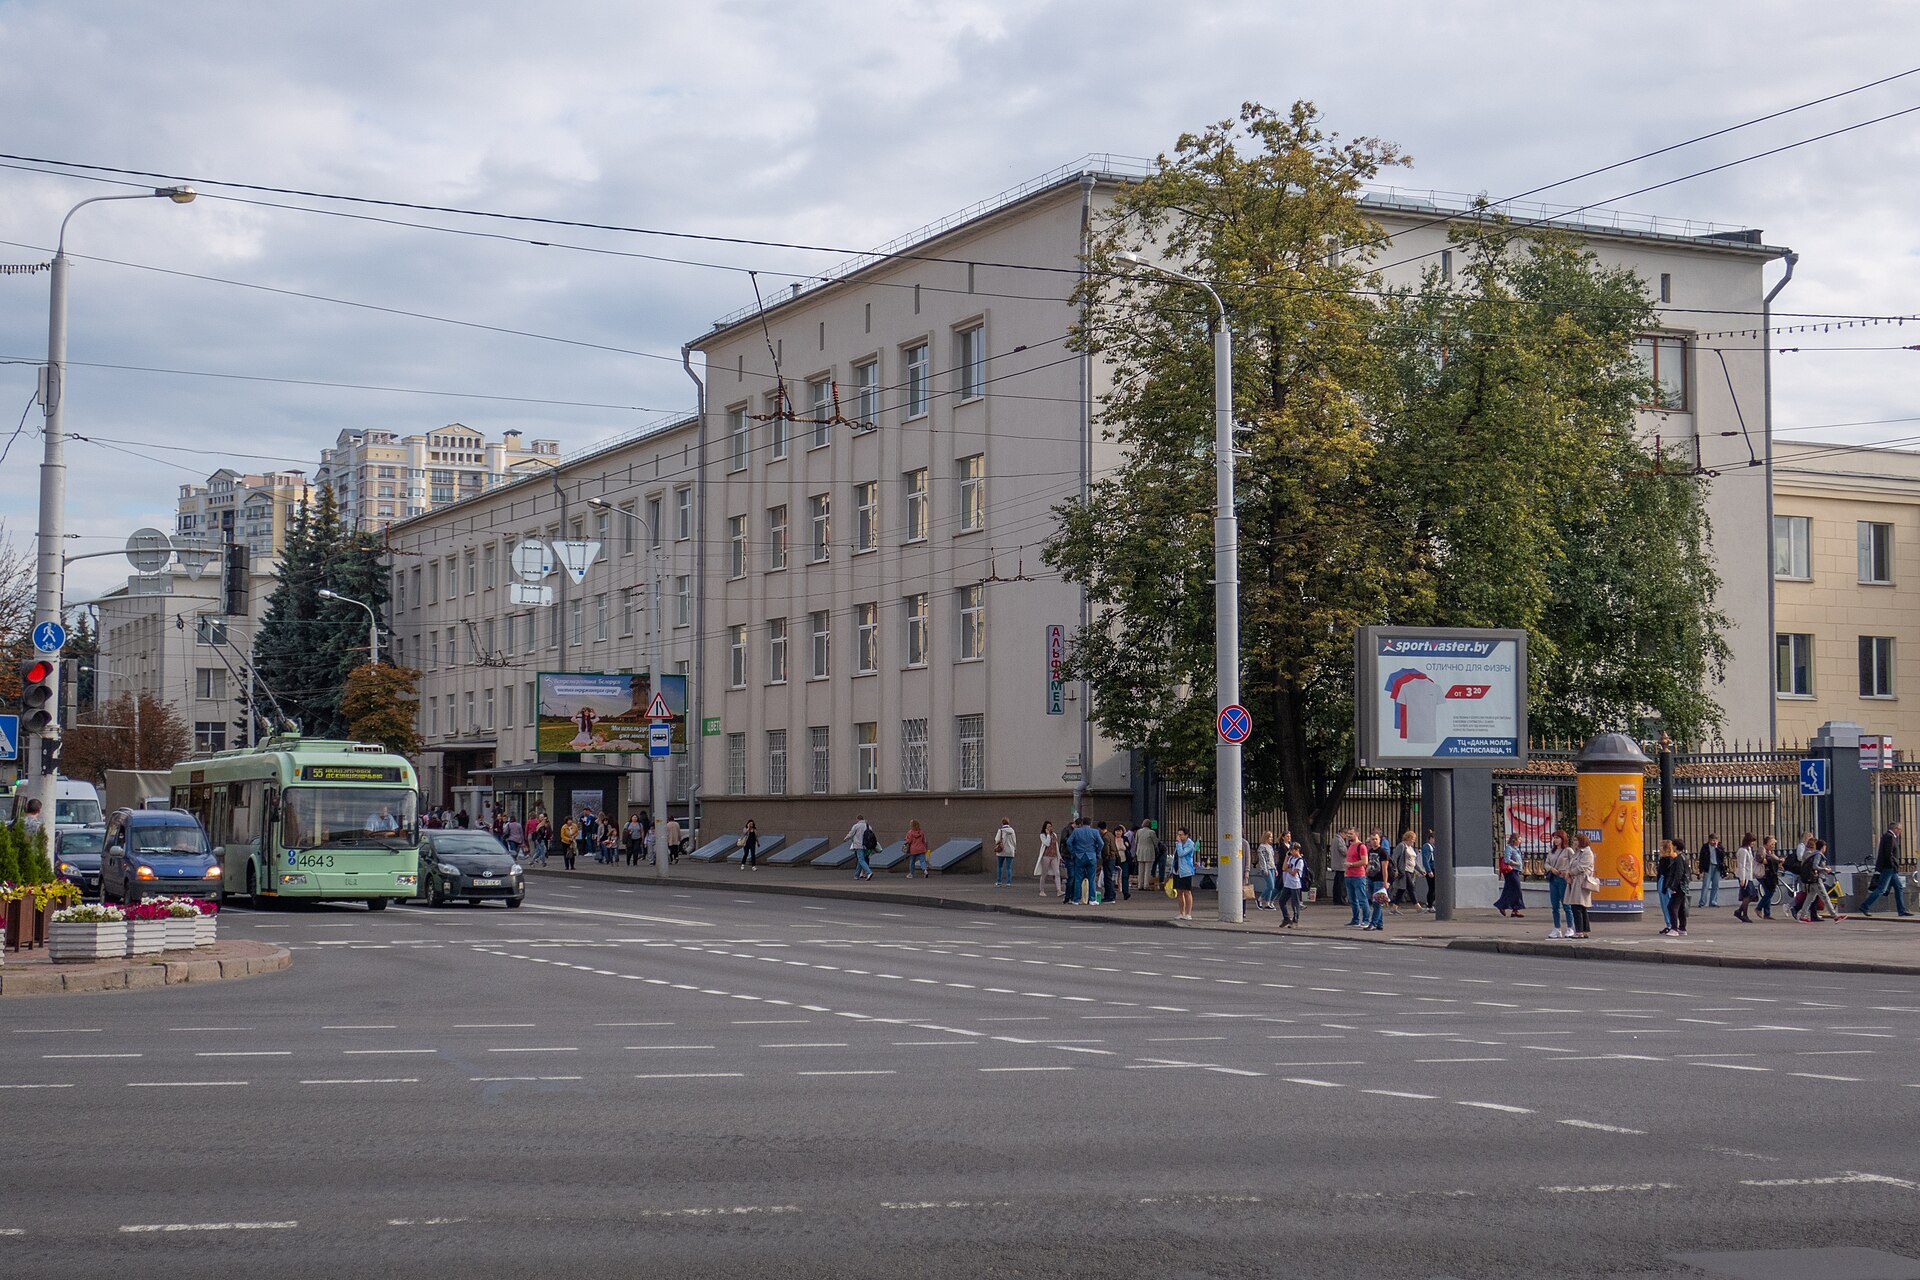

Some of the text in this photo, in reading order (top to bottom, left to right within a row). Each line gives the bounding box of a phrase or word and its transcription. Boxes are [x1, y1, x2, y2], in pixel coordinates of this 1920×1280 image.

[1396, 640, 1490, 654] sportmaster.by
[1425, 663, 1512, 673] ОТЛИЧНО ДЛЯ ФИЗРЫ
[1457, 739, 1467, 747] ТЦ
[1460, 747, 1505, 755] МСТИСЛАВЦА,
[312, 768, 324, 778] 55
[299, 855, 334, 868] 4643
